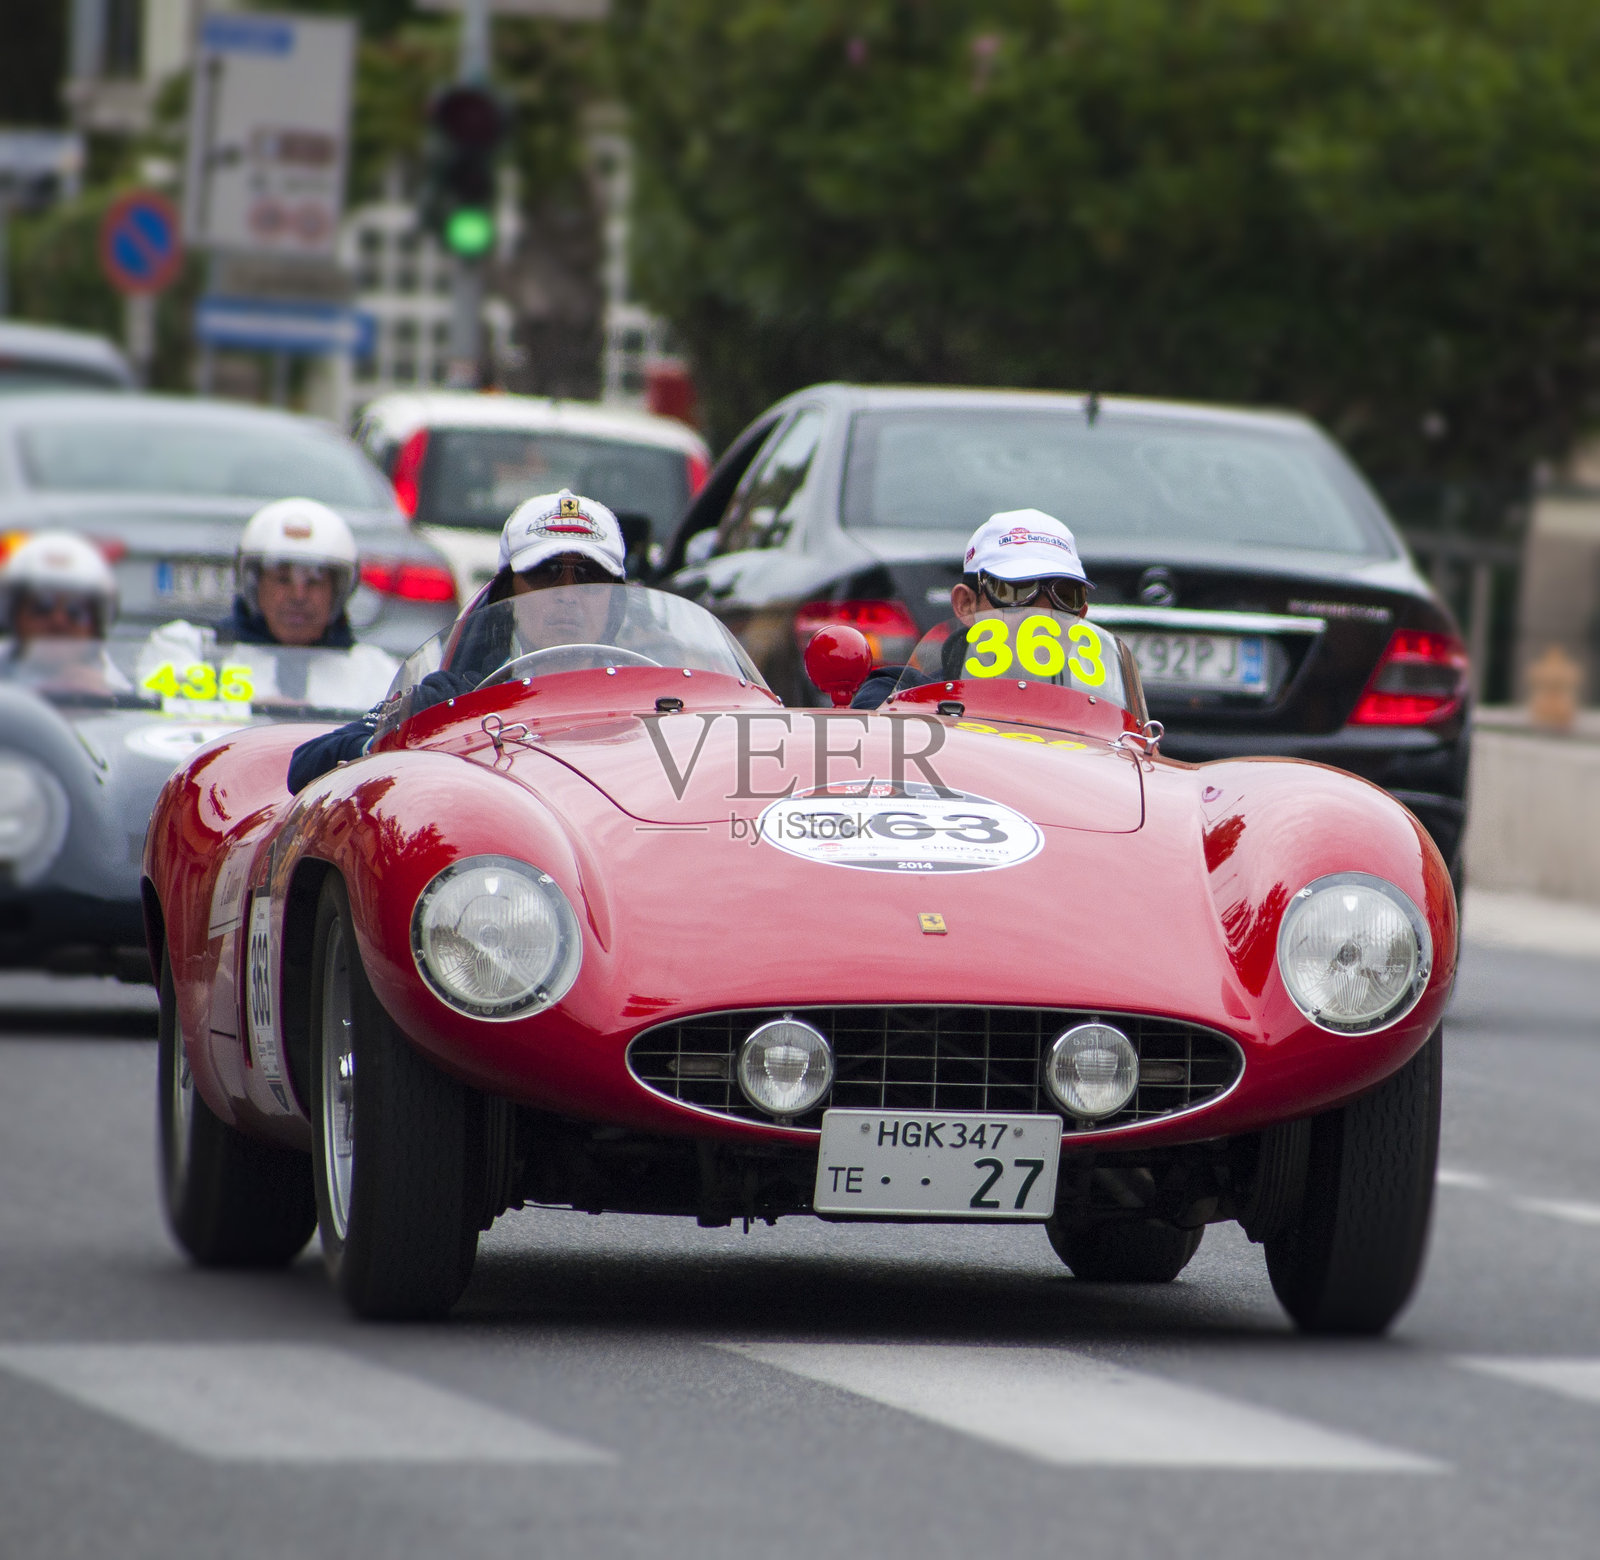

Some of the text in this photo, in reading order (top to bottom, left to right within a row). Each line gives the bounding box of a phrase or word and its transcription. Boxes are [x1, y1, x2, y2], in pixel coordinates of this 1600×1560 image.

[1027, 534, 1051, 543] Banco
[965, 615, 1106, 687] 363
[145, 663, 254, 702] 435
[795, 811, 1009, 844] 363
[897, 861, 934, 870] 2014
[251, 932, 271, 1027] 363
[877, 1120, 1009, 1150] HGK347
[828, 1157, 1045, 1209] TE 27
